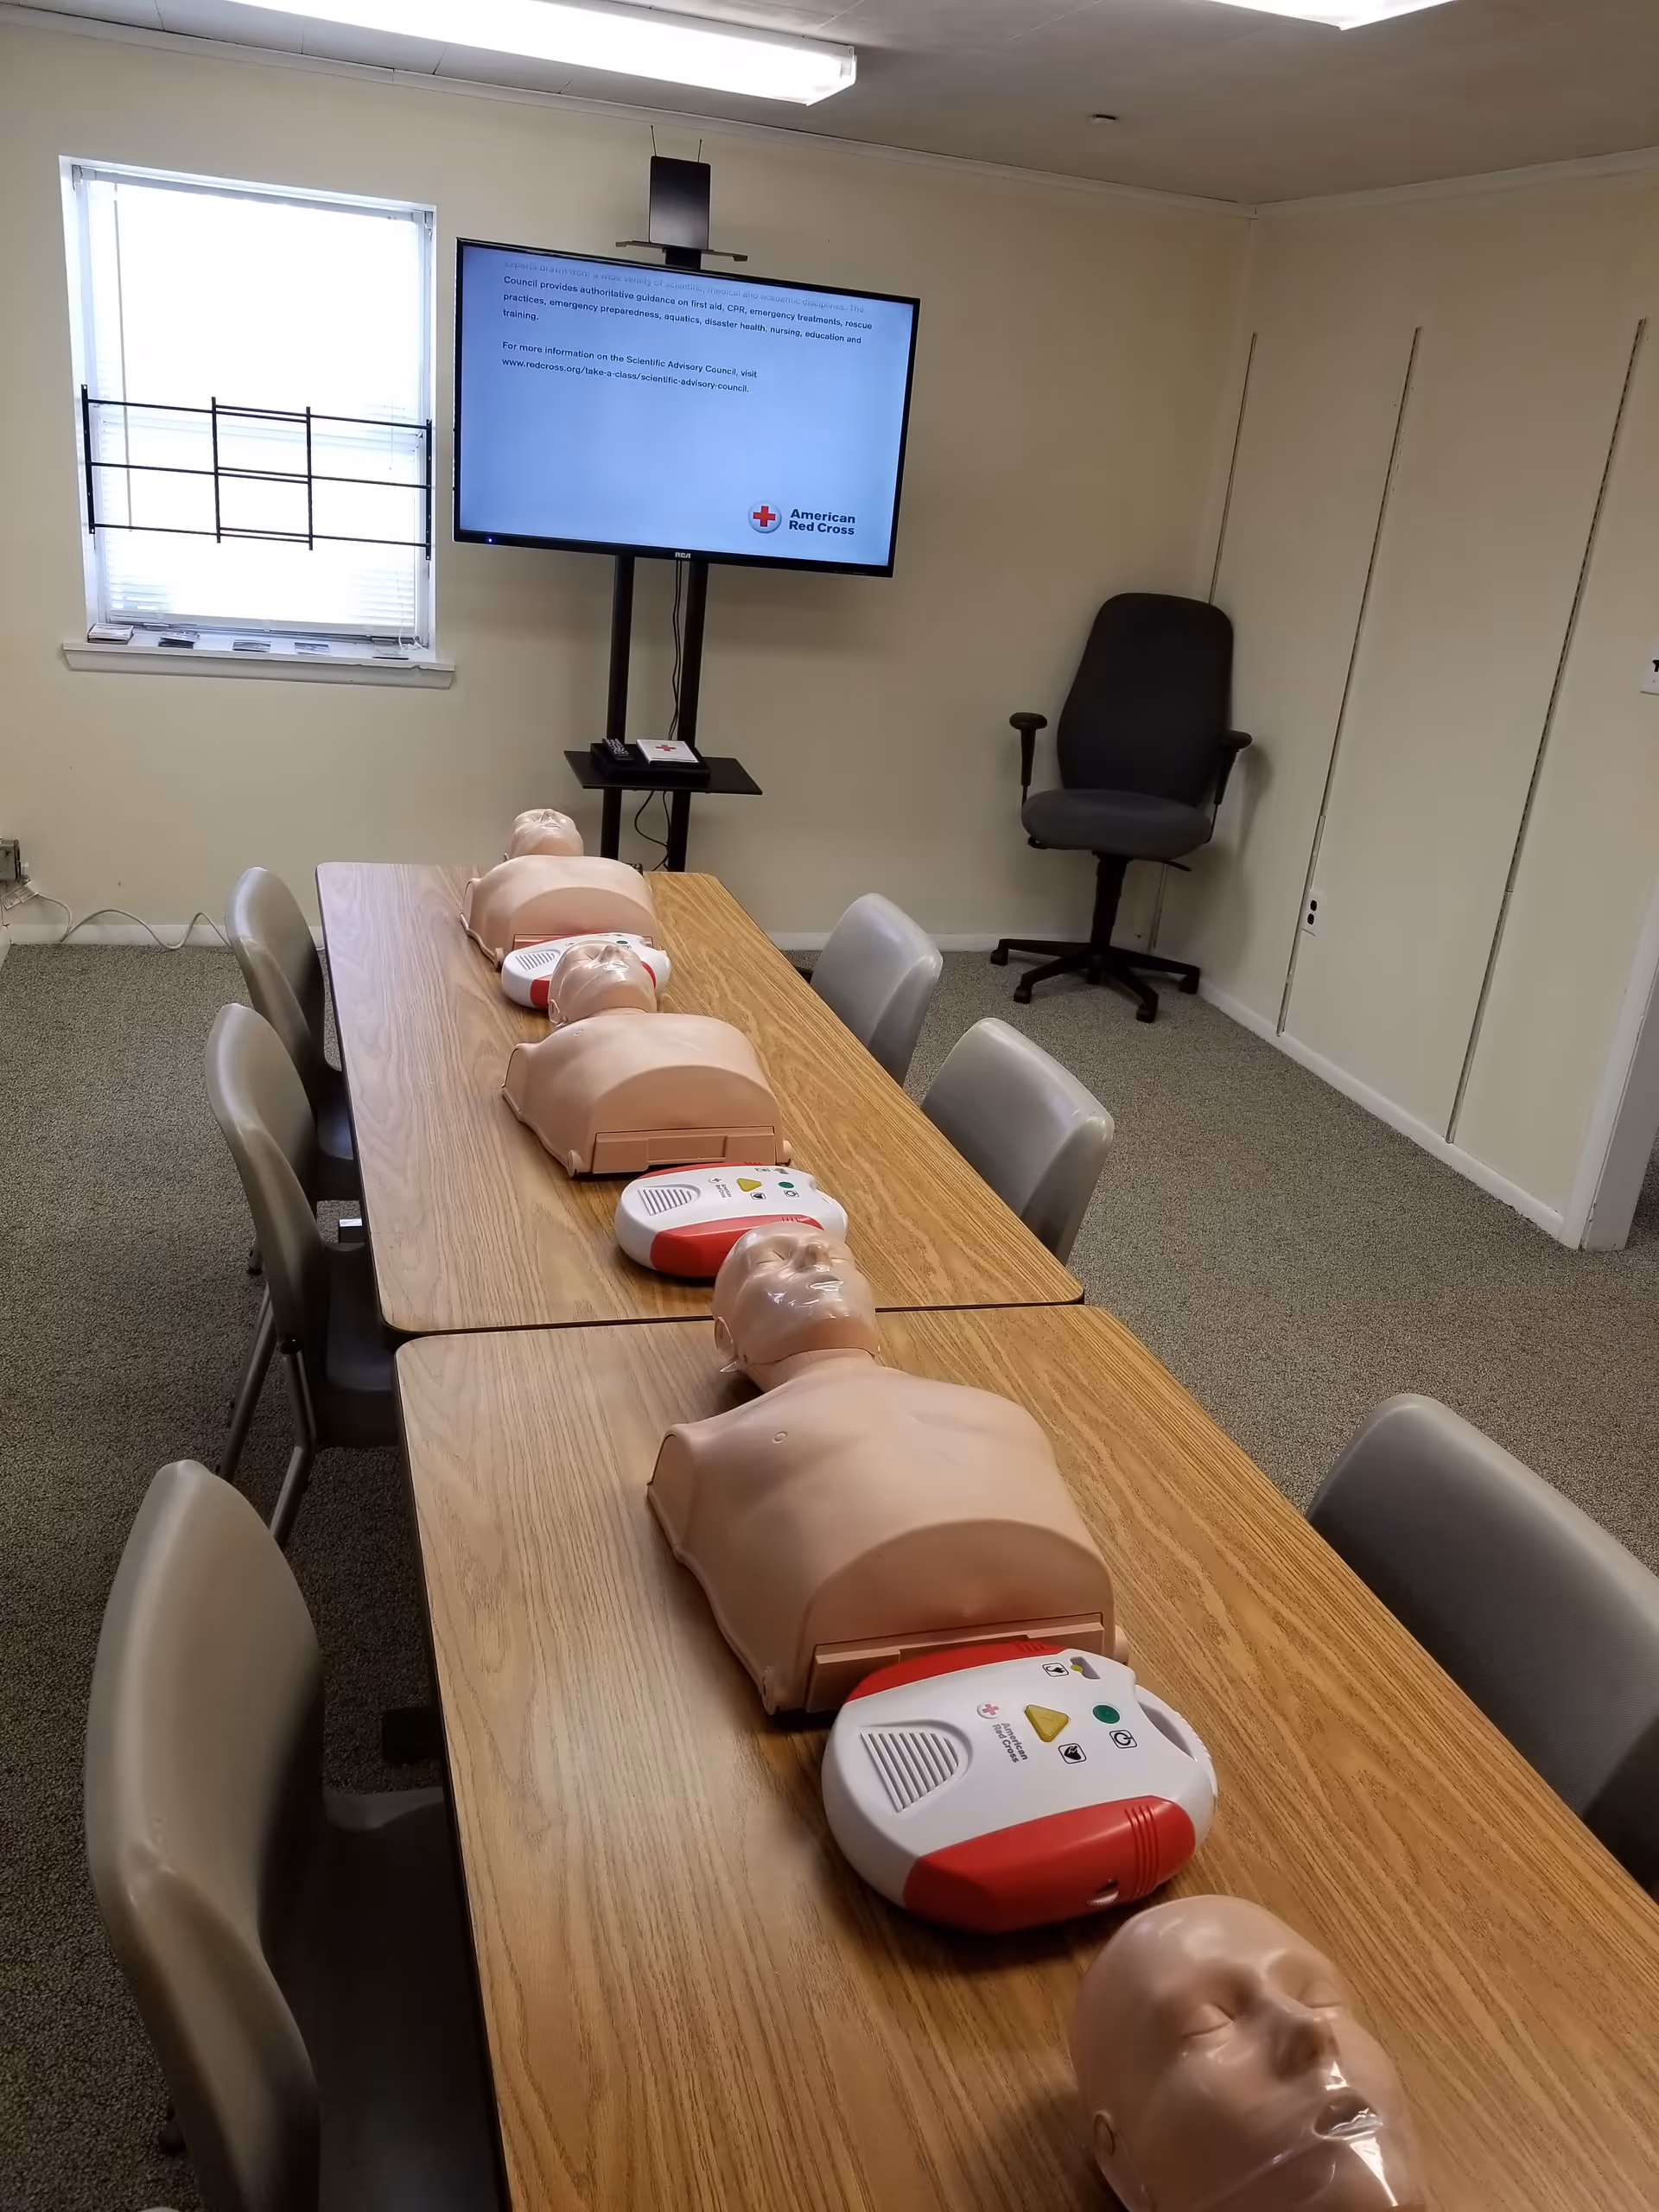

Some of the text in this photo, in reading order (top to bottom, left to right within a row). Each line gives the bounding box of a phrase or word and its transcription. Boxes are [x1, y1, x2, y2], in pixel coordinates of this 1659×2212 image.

[502, 308, 539, 321] training.
[503, 292, 861, 345] practices, emergency preparedness, aquatics, disaster health, nursing, education and
[504, 275, 873, 330] Council provides authoritative guidance on first aid, CPR, emergency treatments, rescue
[502, 341, 518, 350] For
[519, 345, 543, 353] more
[544, 346, 594, 359] information
[610, 353, 625, 363] the
[626, 355, 665, 368] Scientific
[668, 360, 703, 373] Advisory
[705, 365, 739, 378] Council,
[741, 369, 758, 378] visit
[502, 359, 749, 392] www.redcross.org/take-a-class/scientific-advisory-council.
[789, 520, 855, 535] Red Cross
[790, 508, 855, 524] American
[992, 1723, 1020, 1763] Red Cross
[1001, 1722, 1028, 1760] American
